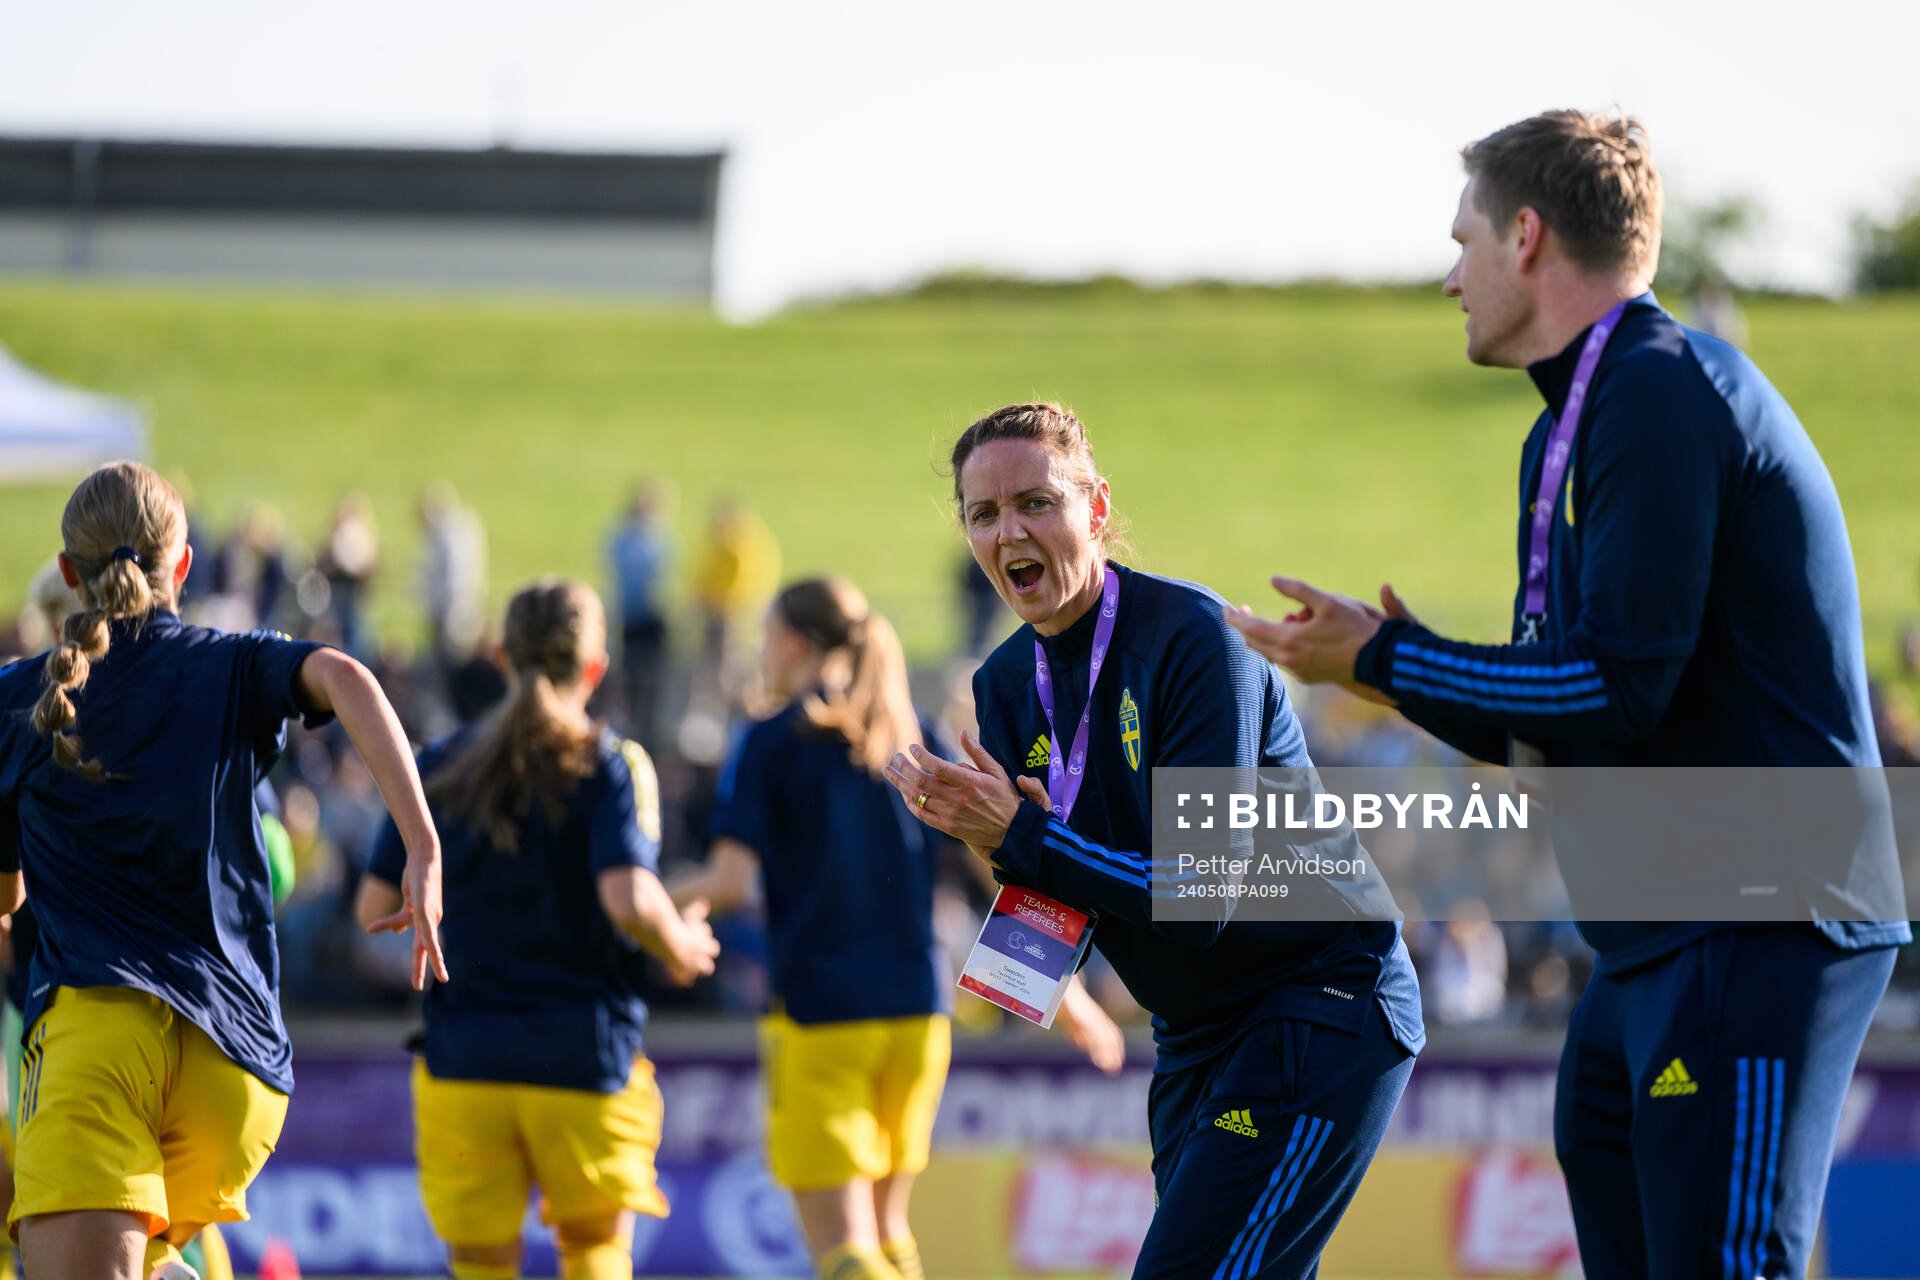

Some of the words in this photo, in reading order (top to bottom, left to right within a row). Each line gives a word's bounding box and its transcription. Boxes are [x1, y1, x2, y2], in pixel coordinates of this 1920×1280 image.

[1026, 754, 1050, 769] adid
[1023, 894, 1057, 918] TEAMS
[1058, 912, 1067, 922] &
[1014, 903, 1065, 934] REFEREES
[1649, 1081, 1698, 1098] adidas
[1214, 1118, 1259, 1138] adidas
